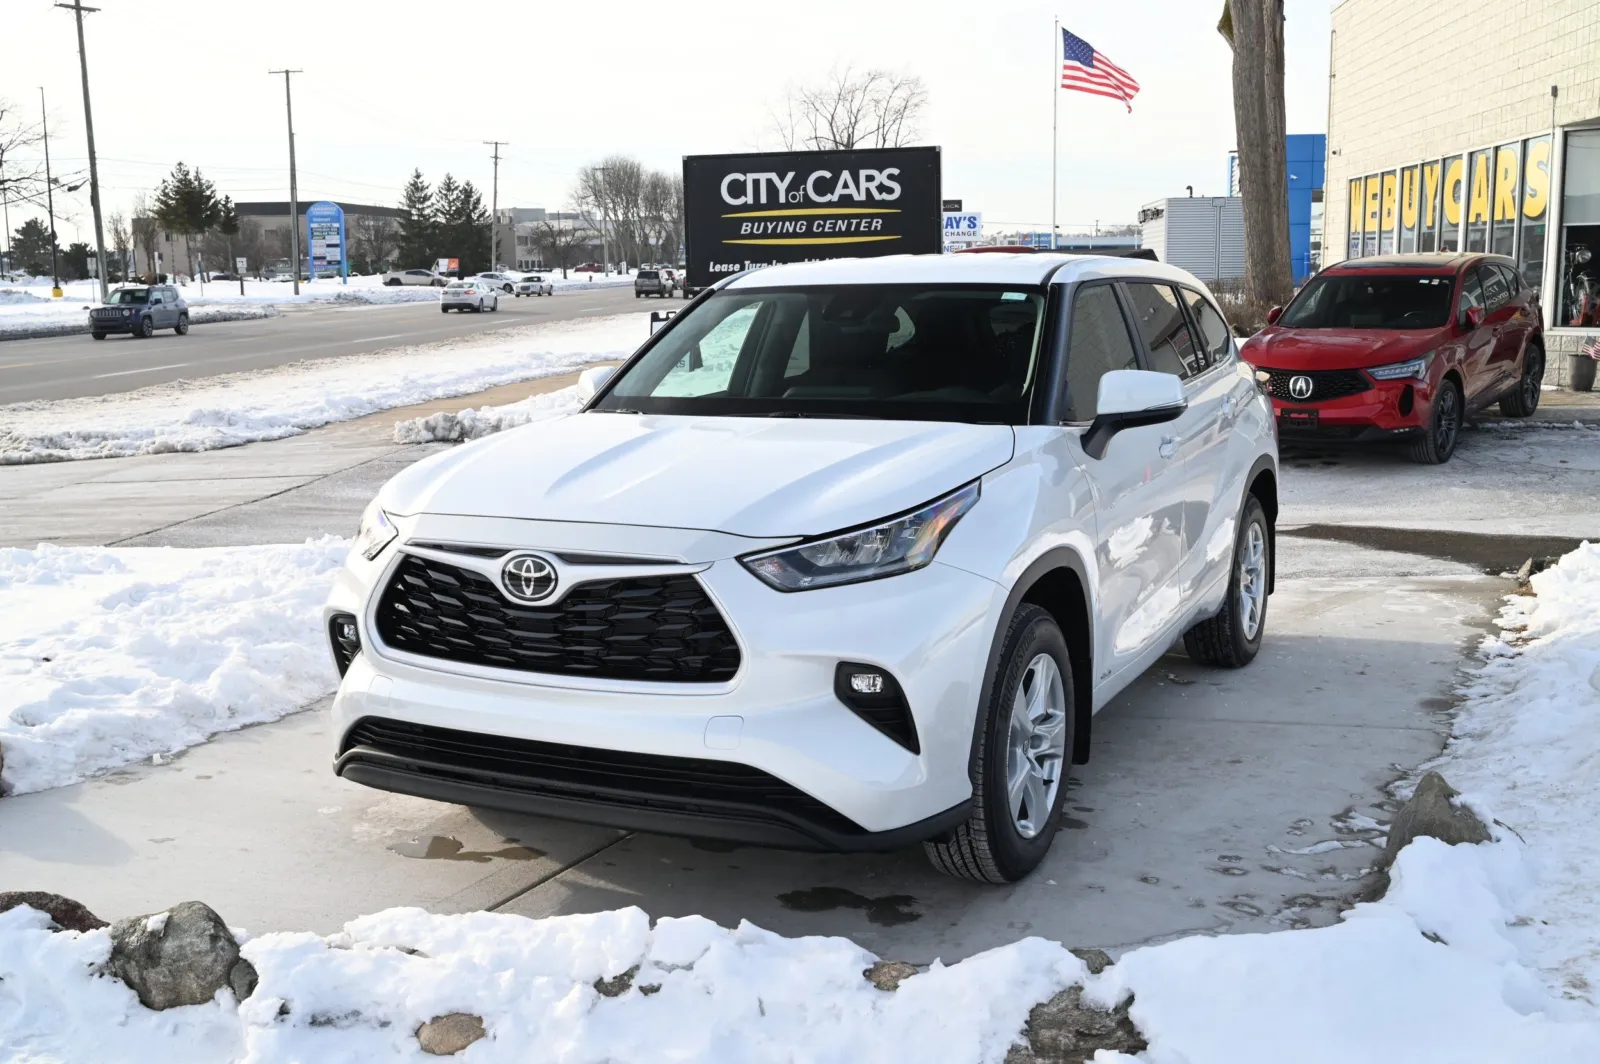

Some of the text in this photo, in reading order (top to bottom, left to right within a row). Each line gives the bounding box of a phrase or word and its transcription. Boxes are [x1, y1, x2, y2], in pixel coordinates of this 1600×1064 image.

[720, 167, 902, 205] CITY of CARS
[1443, 140, 1550, 224] CARS
[740, 218, 883, 234] BUYING CENTER
[944, 215, 977, 229] AY'S
[709, 261, 741, 272] Lease
